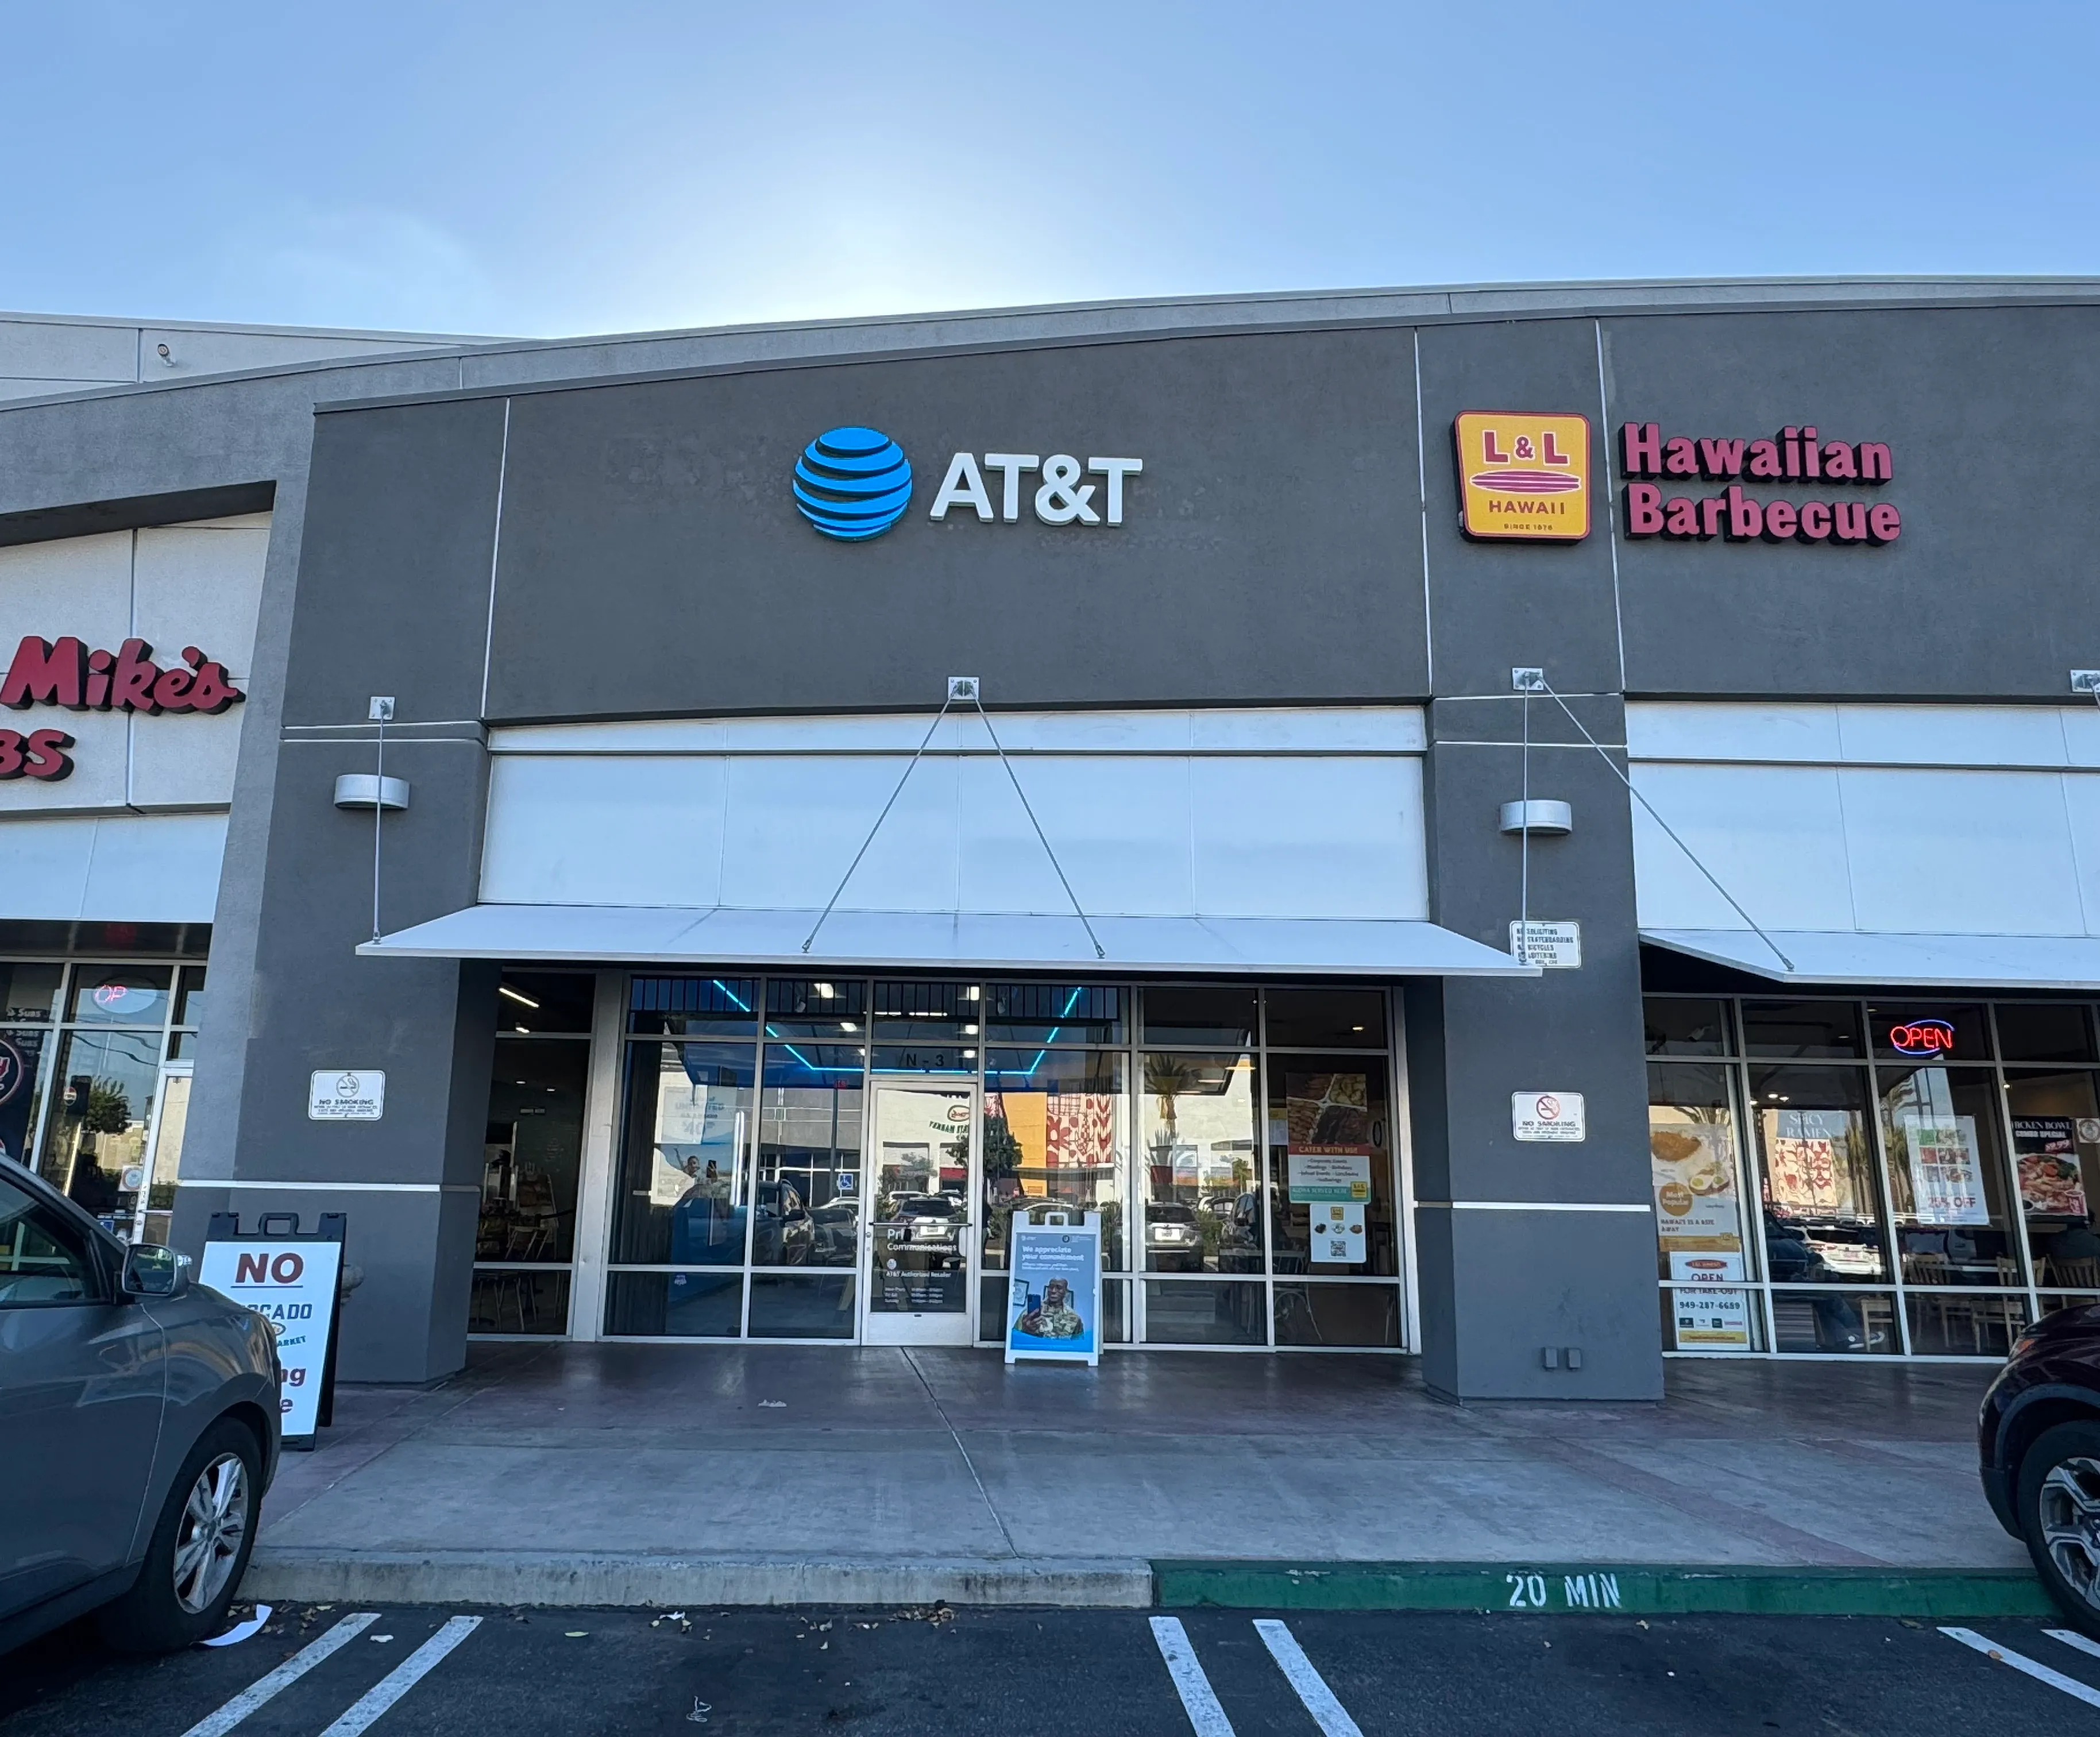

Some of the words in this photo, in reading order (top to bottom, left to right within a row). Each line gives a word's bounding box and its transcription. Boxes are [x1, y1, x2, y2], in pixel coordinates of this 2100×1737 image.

[1624, 422, 1893, 481] Hawaiian
[930, 453, 1142, 527] AT&T
[1489, 500, 1565, 515] HAWAII
[1627, 483, 1902, 542] Barbecue
[0, 636, 244, 714] Mike's
[1890, 1026, 1953, 1049] OPEN
[1789, 1113, 1823, 1125] SPICY
[2045, 1122, 2072, 1130] BOWL
[1786, 1126, 1833, 1138] RAMEN
[235, 1253, 304, 1284] NO
[1692, 1273, 1723, 1281] OPEN
[277, 1335, 306, 1348] ARKET
[1506, 1573, 1546, 1607] 20
[1565, 1573, 1622, 1608] MIN
